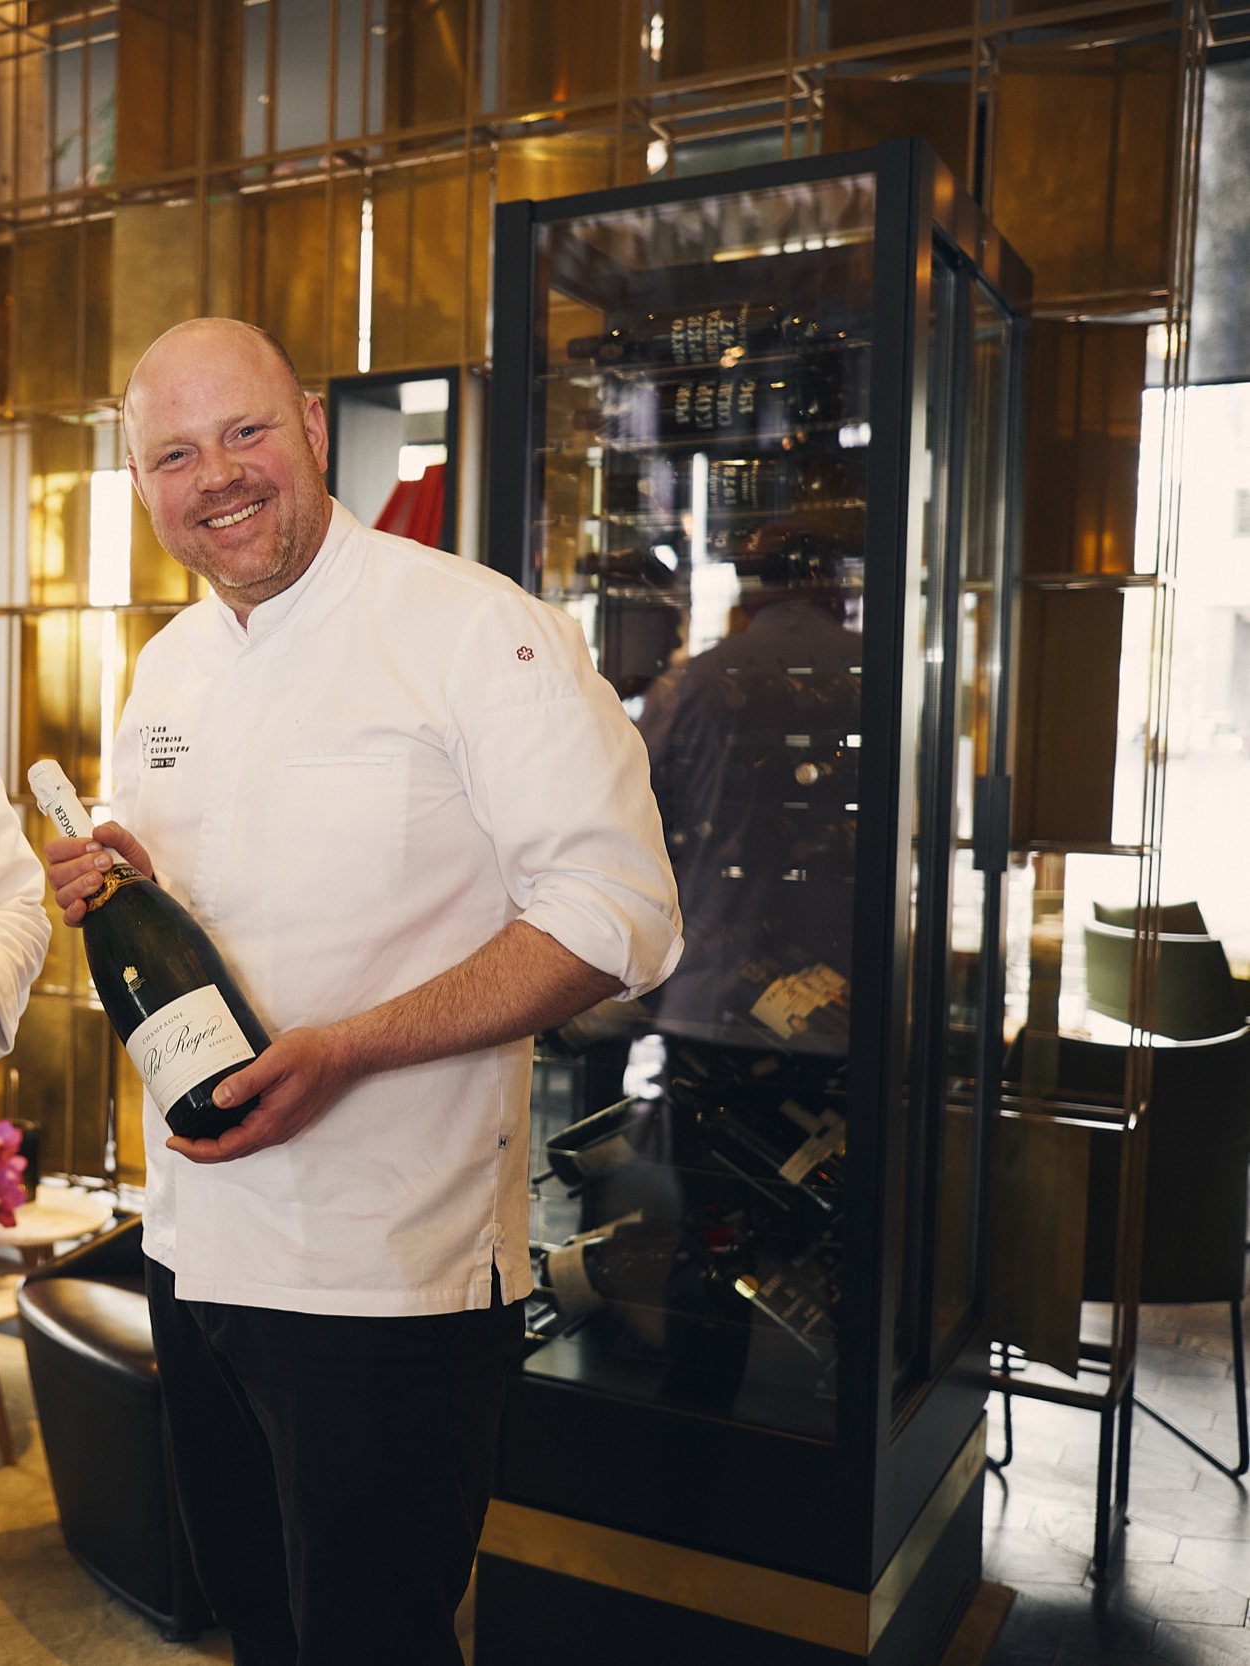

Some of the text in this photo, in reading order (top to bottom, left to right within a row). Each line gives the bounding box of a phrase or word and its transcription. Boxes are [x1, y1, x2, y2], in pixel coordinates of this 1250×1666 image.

[671, 318, 686, 365] ORTO
[675, 382, 692, 424] POR
[695, 381, 715, 429] KOP
[738, 379, 756, 415] 196
[151, 735, 182, 743] PATRONS
[142, 1011, 185, 1045] CHAMPAGNE
[143, 1043, 162, 1086] Pol
[164, 1015, 223, 1065] Roger
